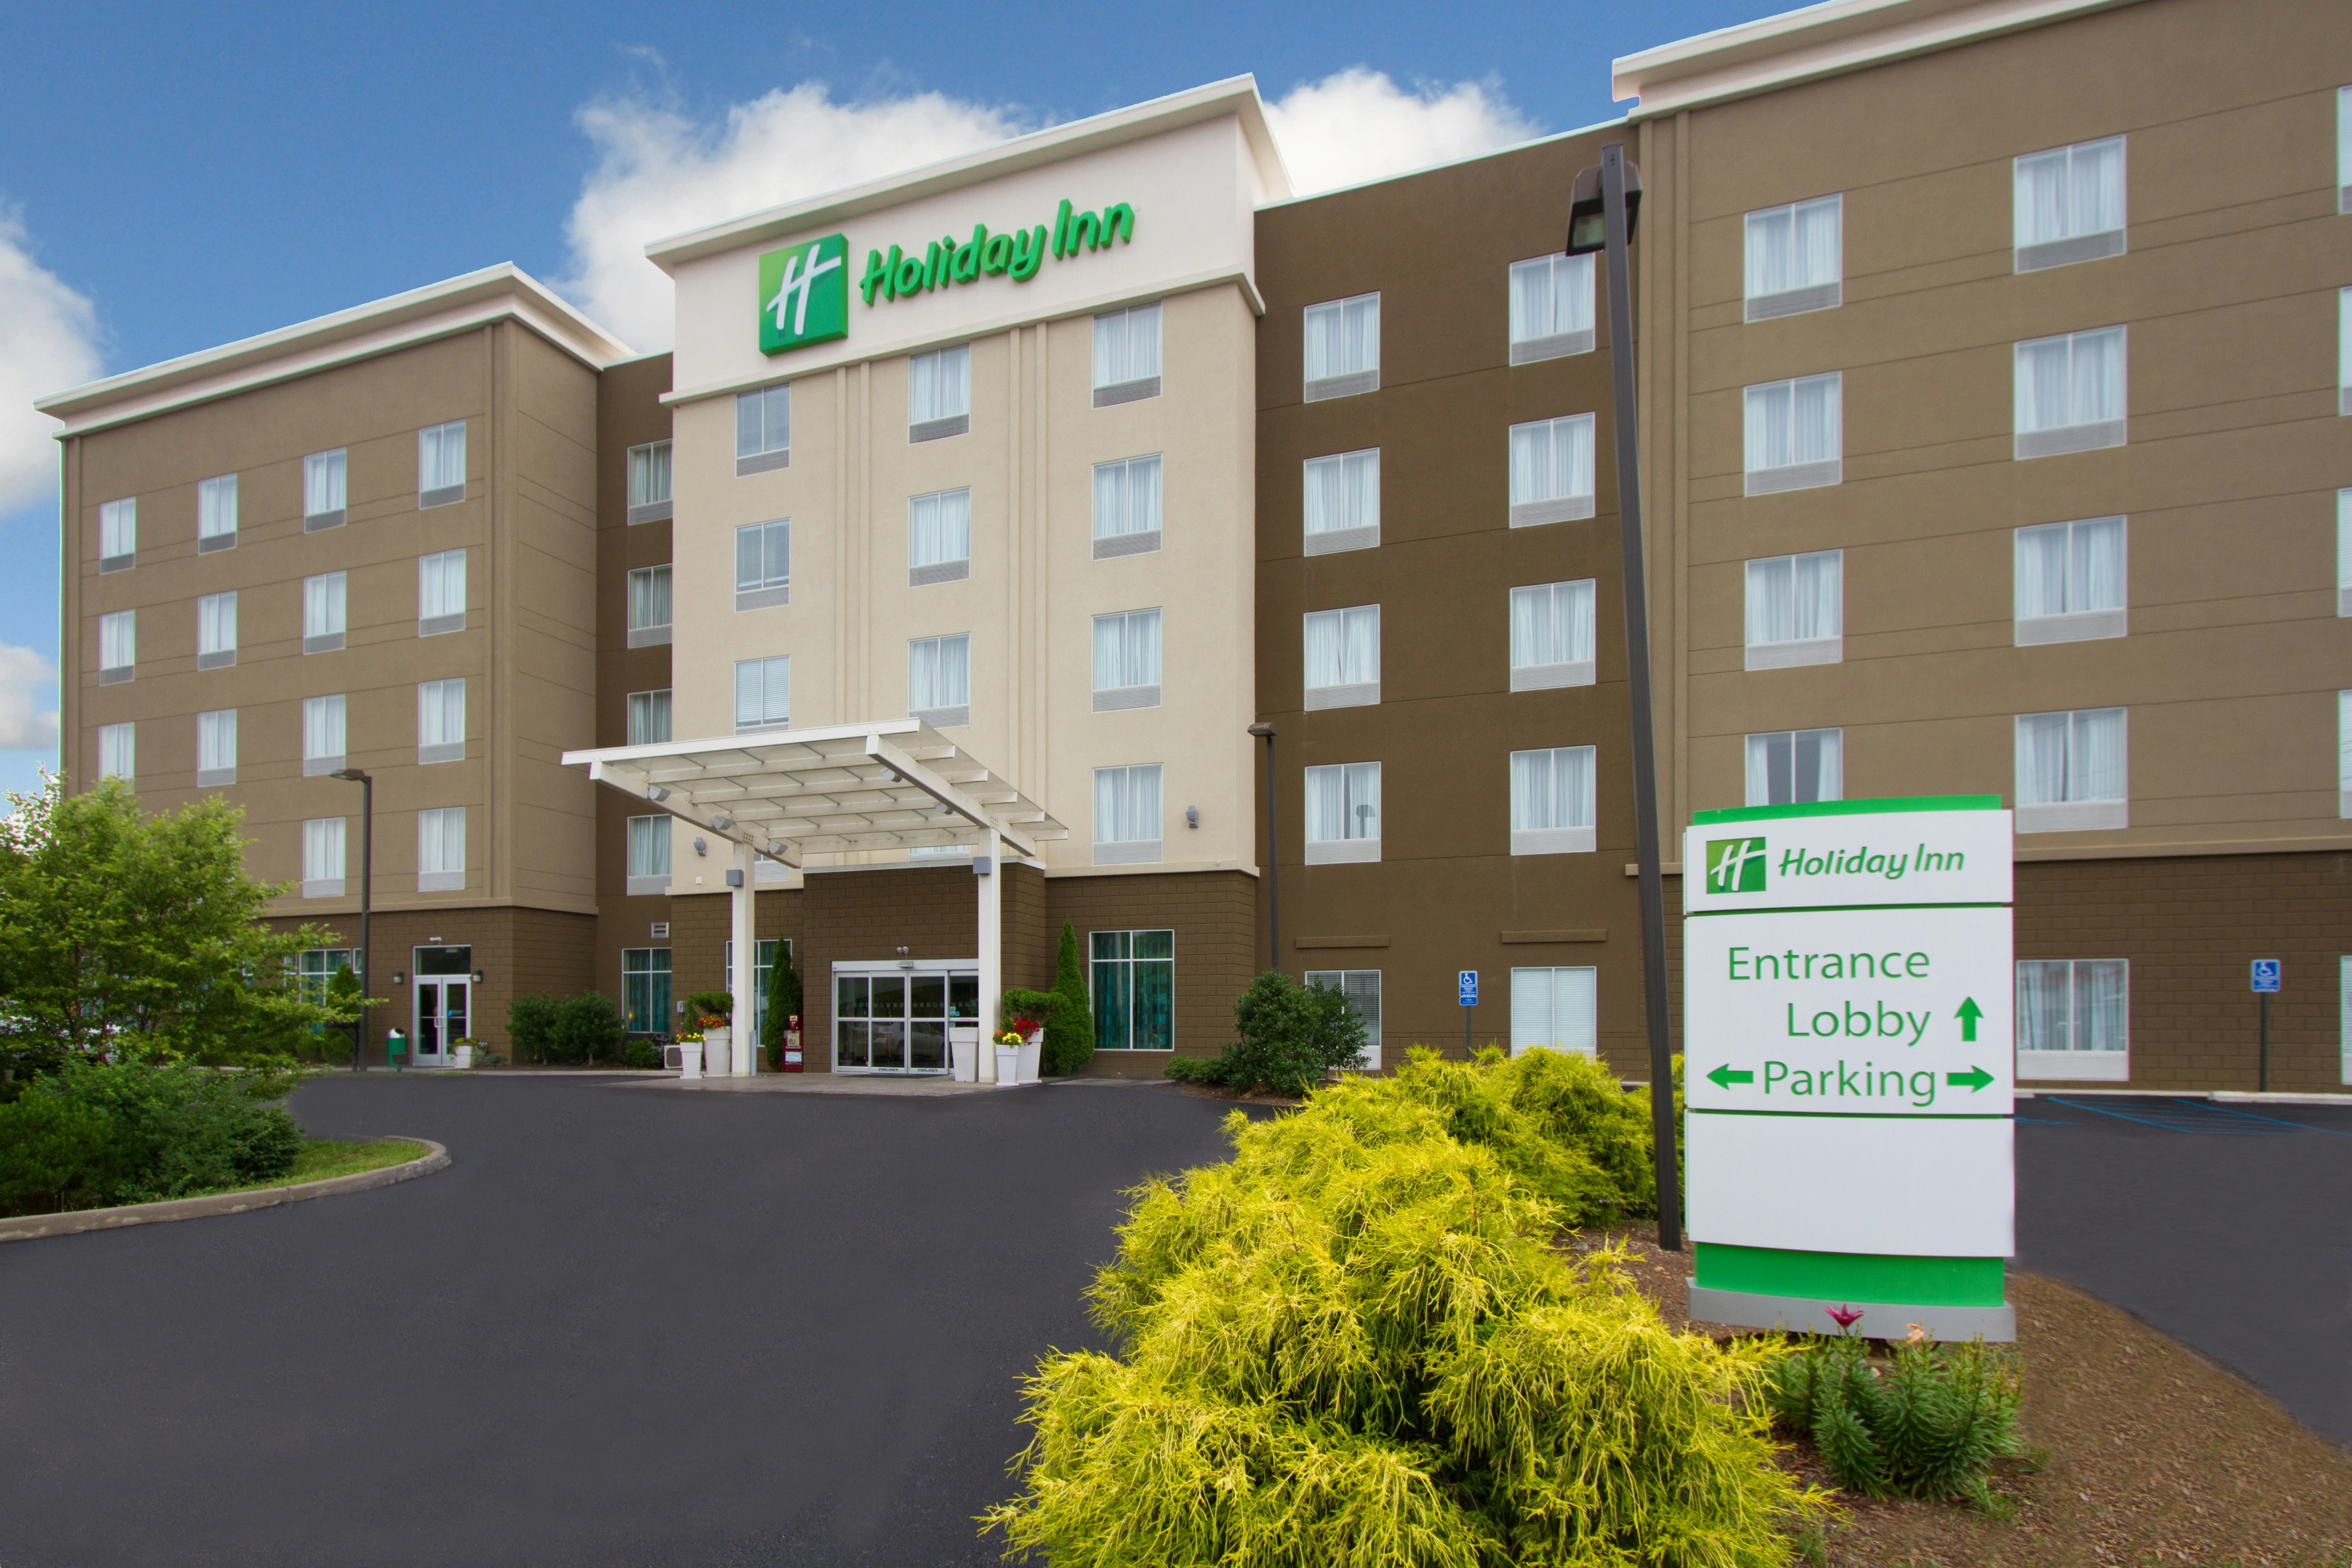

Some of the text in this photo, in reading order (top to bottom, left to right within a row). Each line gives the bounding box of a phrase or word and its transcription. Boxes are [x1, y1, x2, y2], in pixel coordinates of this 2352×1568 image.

[859, 197, 1136, 307] Holiday Inn
[1778, 843, 1965, 879] Holiday Inn
[1729, 947, 1930, 981] Entrance
[1788, 1001, 1931, 1047] Lobby
[1764, 1060, 1936, 1107] Parking
